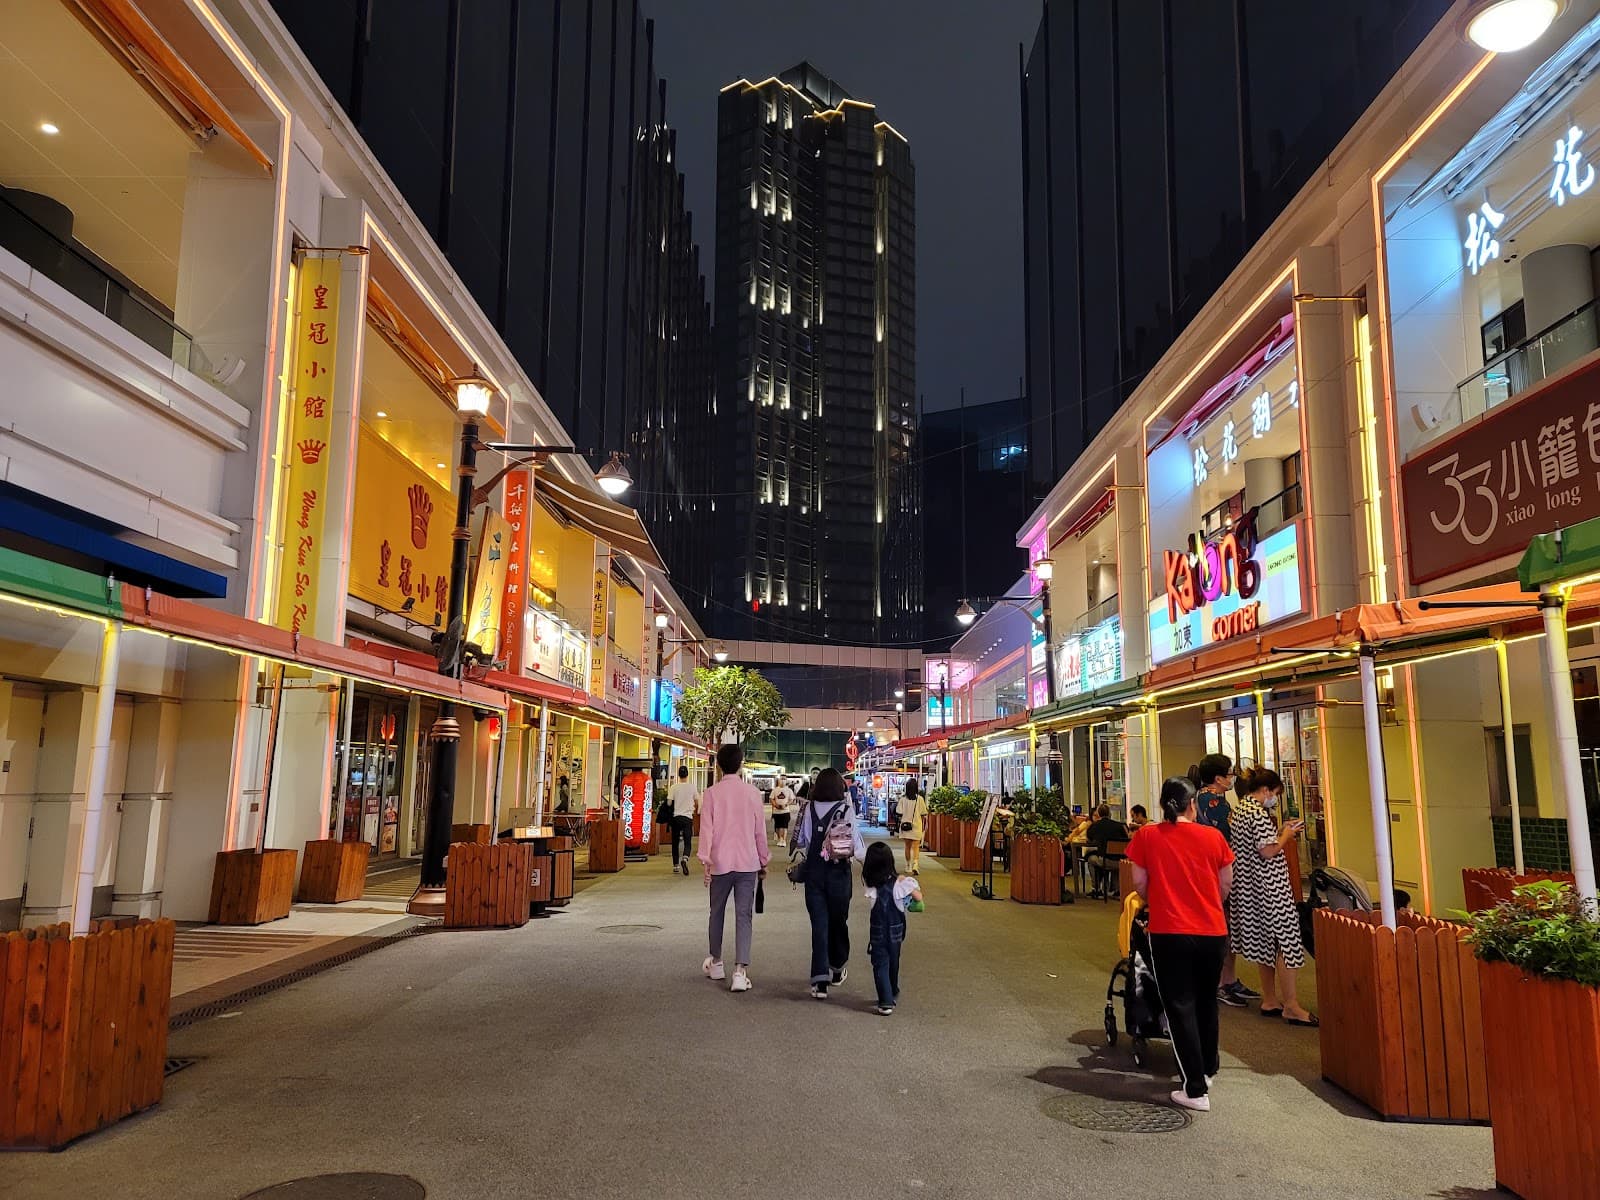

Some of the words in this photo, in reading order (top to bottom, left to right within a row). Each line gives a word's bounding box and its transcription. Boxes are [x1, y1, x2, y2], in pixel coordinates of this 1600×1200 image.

[1464, 125, 1595, 276] 松花
[303, 284, 330, 420] 皇冠小館
[297, 489, 317, 530] Wong
[1505, 502, 1536, 527] xiao
[1544, 484, 1582, 511] long
[296, 535, 313, 567] Kun
[377, 539, 449, 613] 皇冠小館
[1174, 623, 1193, 653] 加東
[1211, 600, 1260, 642] corner
